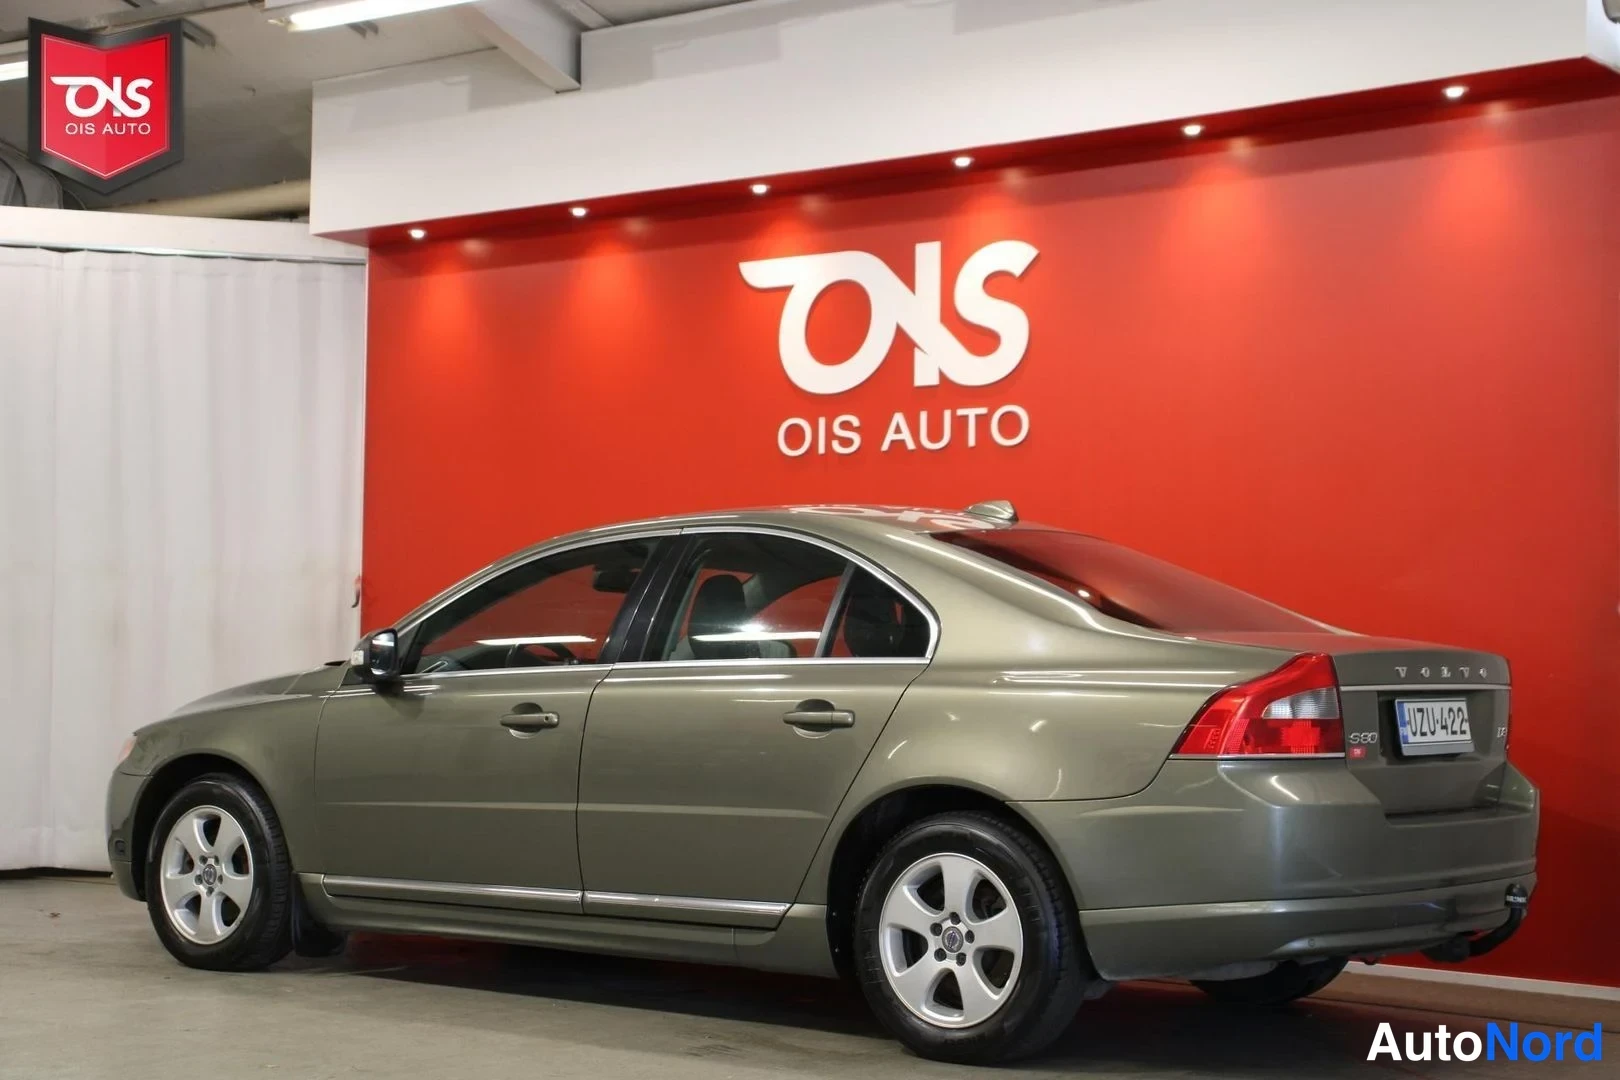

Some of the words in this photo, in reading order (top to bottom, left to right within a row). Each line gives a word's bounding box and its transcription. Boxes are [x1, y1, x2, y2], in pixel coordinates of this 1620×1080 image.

[738, 240, 1040, 395] OIS
[777, 414, 862, 457] OIS
[880, 404, 1031, 452] AUTO
[1394, 666, 1489, 679] VOLVO
[1349, 732, 1378, 744] S80
[1407, 706, 1468, 738] UZU-422
